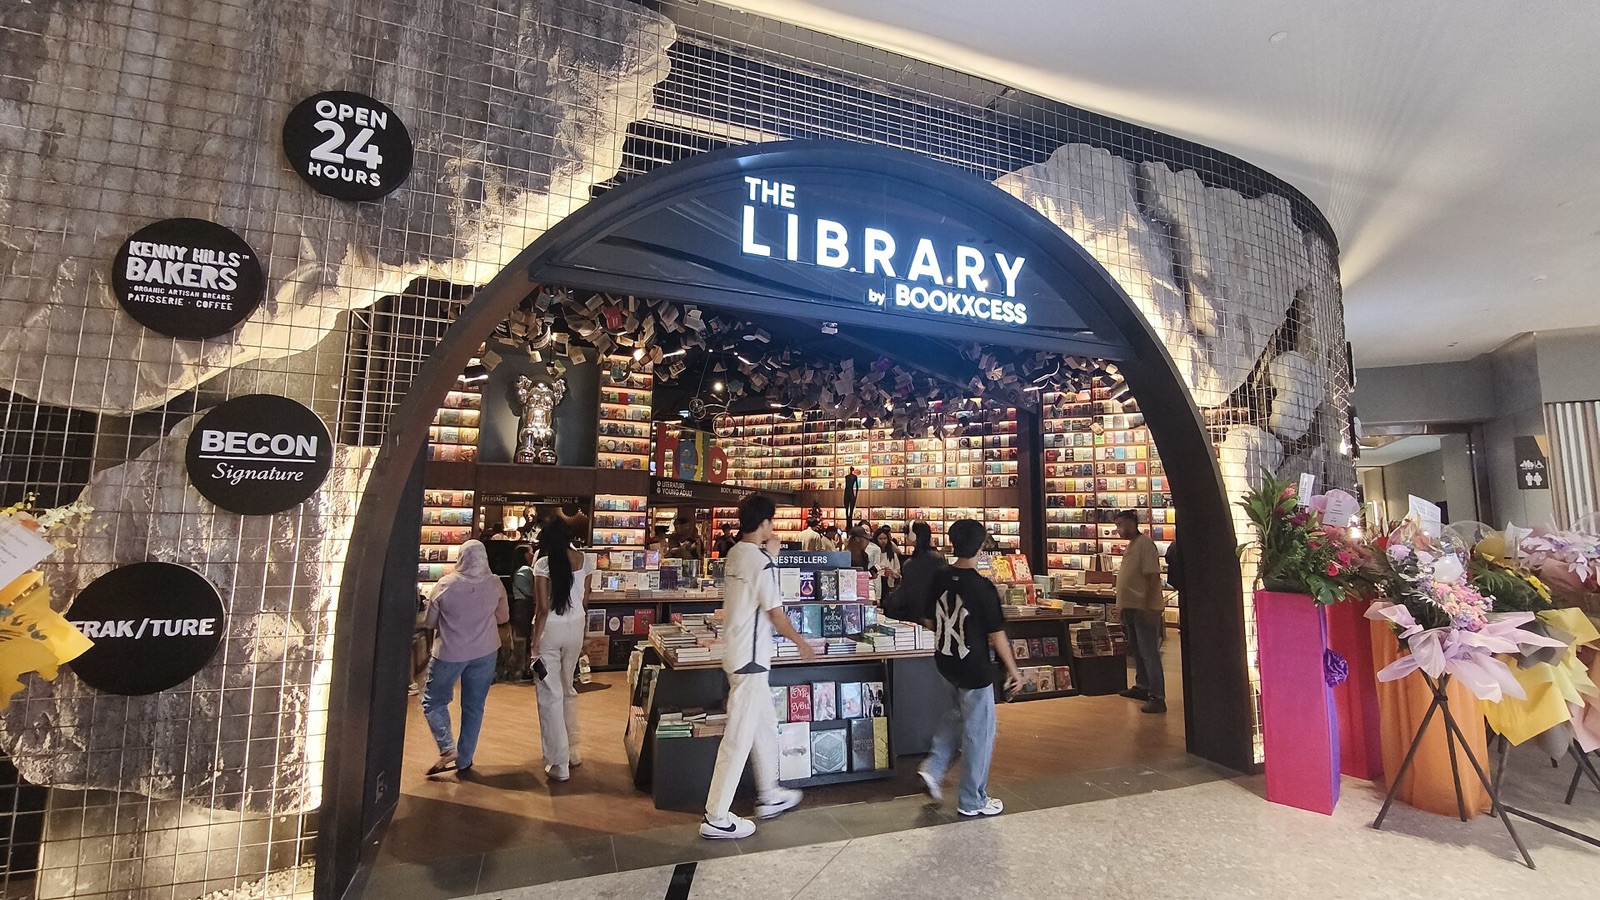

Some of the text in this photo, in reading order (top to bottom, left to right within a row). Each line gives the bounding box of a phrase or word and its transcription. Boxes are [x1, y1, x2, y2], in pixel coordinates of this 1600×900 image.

[315, 99, 388, 130] OPEN
[310, 119, 383, 170] 24
[308, 161, 381, 187] HOURS
[744, 176, 796, 208] THE
[128, 240, 188, 261] KENNY
[742, 205, 1025, 297] LIBRARY
[126, 256, 238, 291] BAKERS
[127, 293, 233, 311] PATISSERIE COFFEE
[133, 285, 231, 300] ORGANIC ARTISAN BREADS
[868, 283, 1028, 325] by BOOKXCESS
[201, 430, 318, 457] BECON
[211, 462, 304, 486] Signature
[662, 481, 685, 489] LITERATURE
[662, 487, 680, 496] YOUNG
